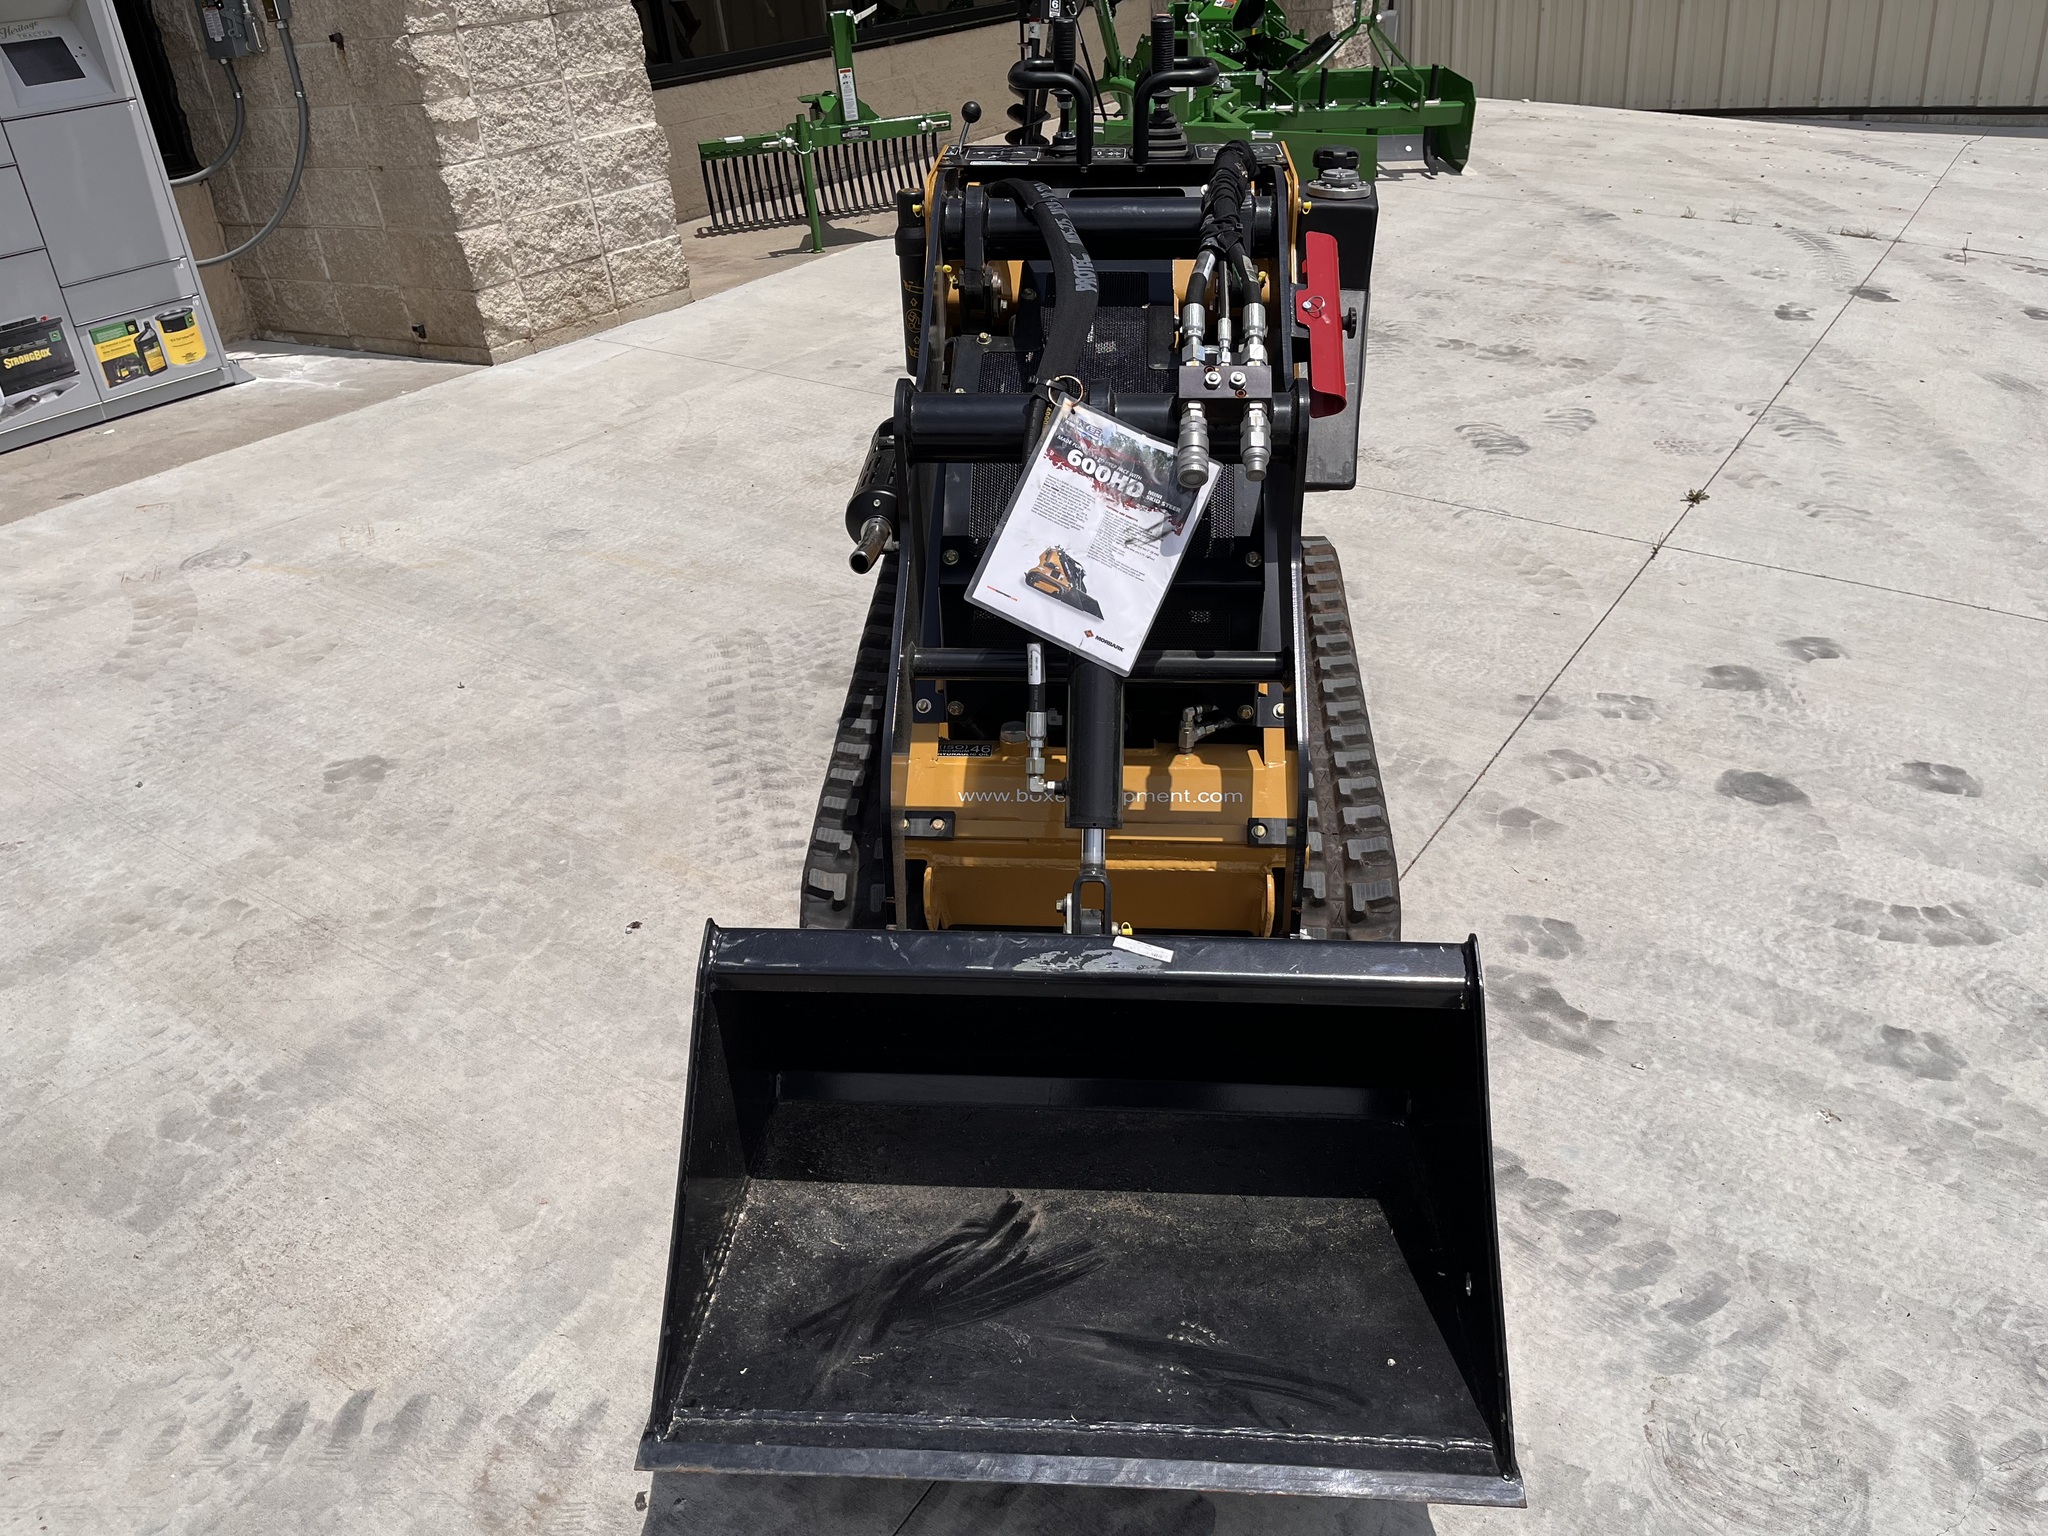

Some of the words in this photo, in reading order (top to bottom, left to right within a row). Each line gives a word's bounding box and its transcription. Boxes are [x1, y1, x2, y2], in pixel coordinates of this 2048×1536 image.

[0, 20, 39, 39] Heritage
[17, 30, 53, 39] TRACTOR
[1067, 449, 1145, 498] 600HD
[1147, 490, 1163, 500] MINI
[1145, 495, 1161, 505] SKID
[1160, 501, 1181, 513] STEER
[1095, 635, 1125, 652] MORBARK
[970, 745, 991, 753] 46
